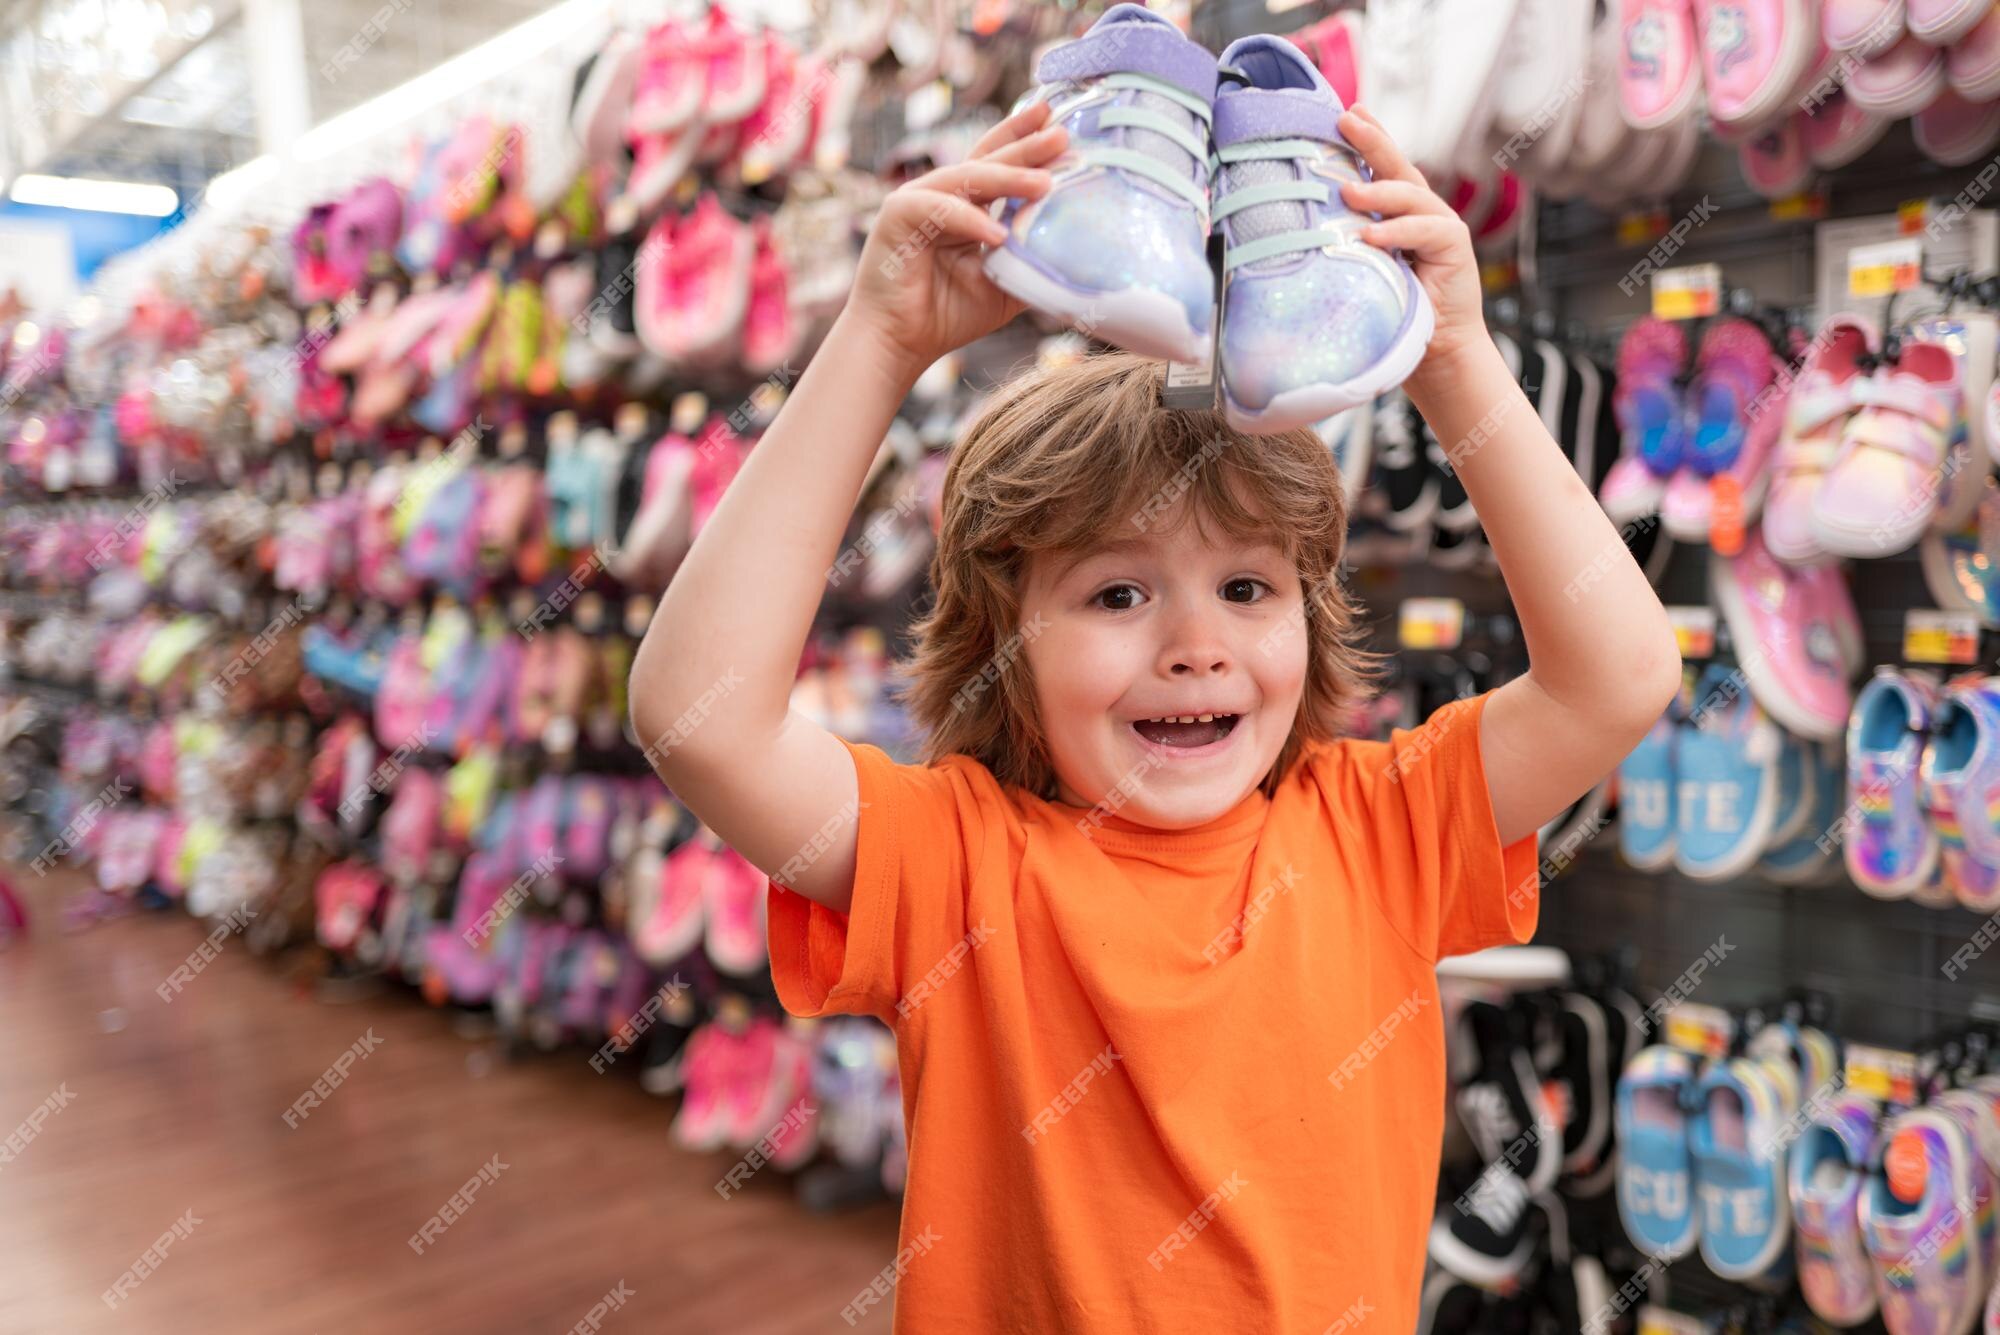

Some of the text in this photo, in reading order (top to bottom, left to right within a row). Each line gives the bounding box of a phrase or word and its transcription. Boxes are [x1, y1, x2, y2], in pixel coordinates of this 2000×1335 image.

[1678, 780, 1742, 833] TE
[1623, 1164, 1688, 1220] CU
[1699, 1182, 1767, 1236] TE
